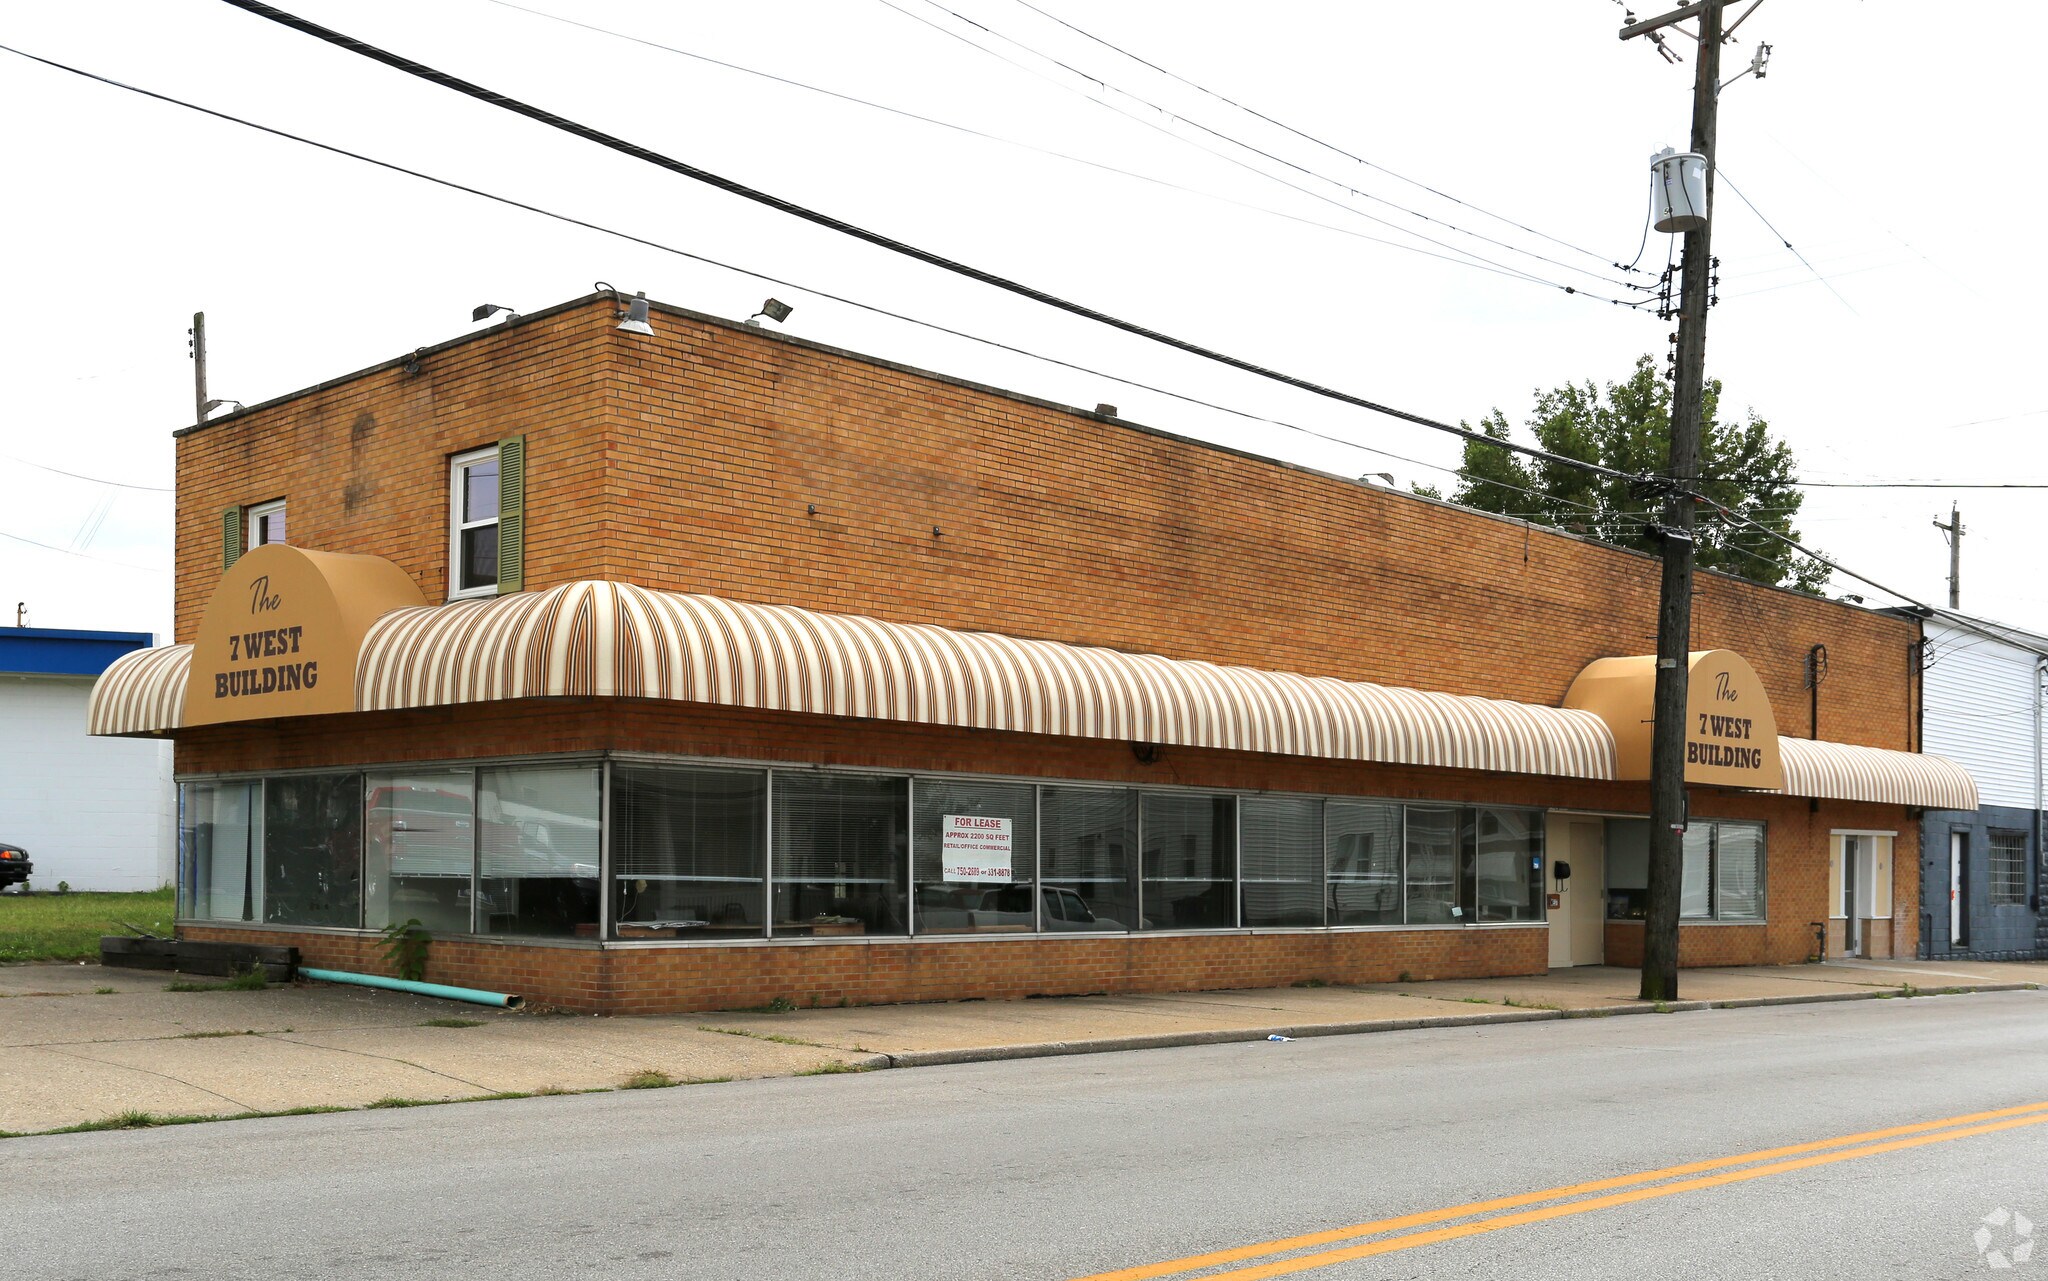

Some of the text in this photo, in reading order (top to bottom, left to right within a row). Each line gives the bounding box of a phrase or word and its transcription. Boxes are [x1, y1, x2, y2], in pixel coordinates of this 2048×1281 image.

[250, 575, 281, 615] The
[230, 626, 302, 661] 7 WEST
[215, 661, 318, 699] BUILDING
[1715, 671, 1738, 702] The
[1699, 713, 1752, 740] 7 WEST
[1687, 741, 1762, 770] BUILDING
[955, 817, 1001, 828] FOR LEASE
